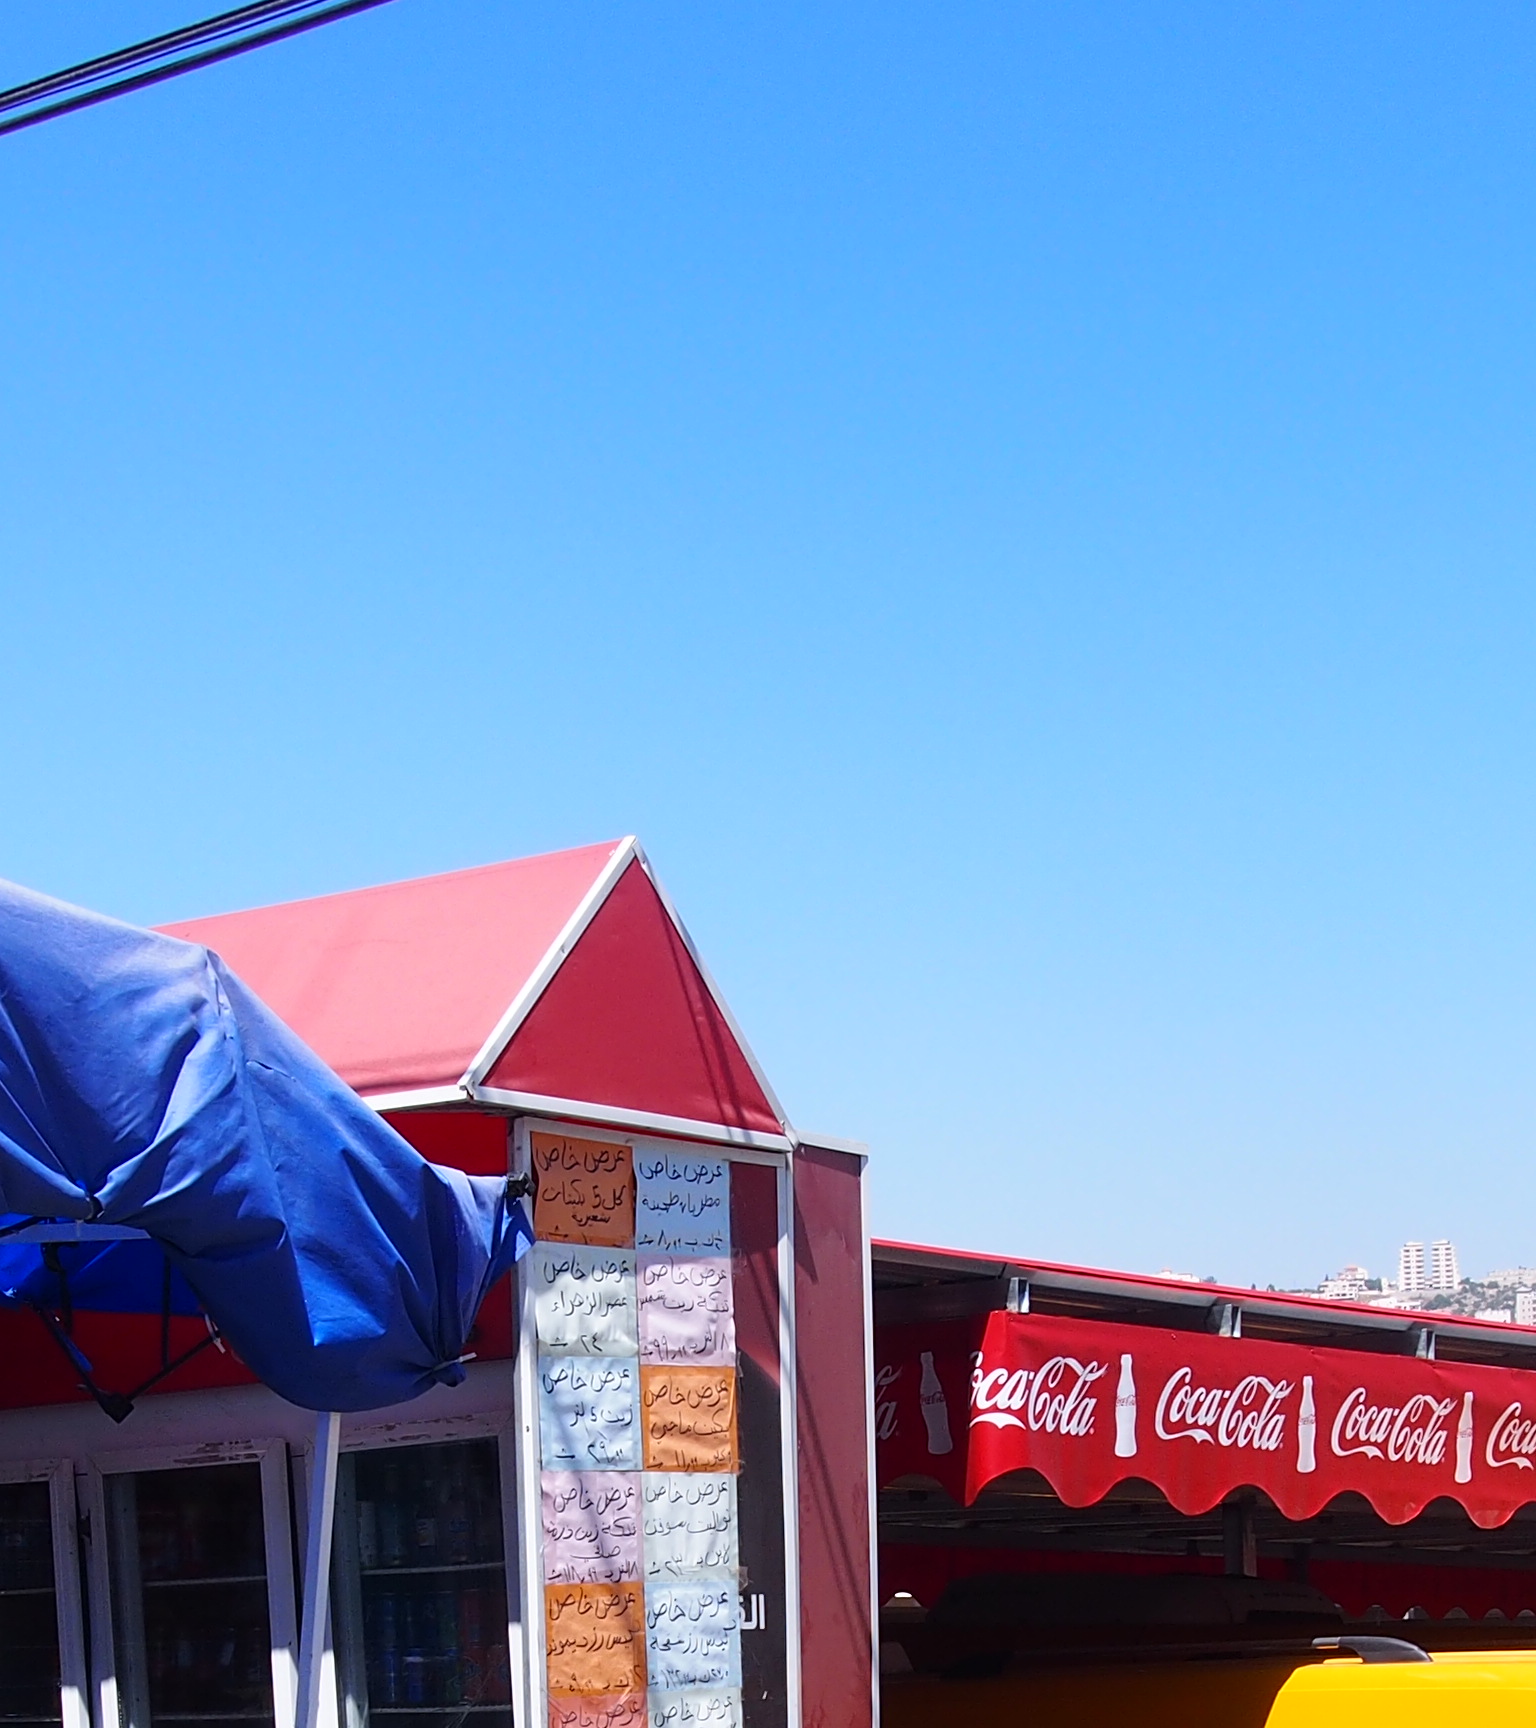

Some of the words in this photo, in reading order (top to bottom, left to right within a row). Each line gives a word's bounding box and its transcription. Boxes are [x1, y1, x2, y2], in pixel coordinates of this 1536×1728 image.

[536, 1141, 581, 1171] خاص
[639, 1154, 682, 1180] خاص
[544, 1254, 586, 1283] خاص
[644, 1256, 688, 1285] خاص
[543, 1363, 587, 1394] خاص
[644, 1375, 685, 1407] خاص
[1155, 1366, 1295, 1450] Coca-Cola
[1331, 1388, 1458, 1465] Coca-Cola
[552, 1478, 594, 1513] خاص
[645, 1478, 683, 1504] خاص
[549, 1587, 592, 1620] خاص
[647, 1590, 686, 1629] خاص
[654, 1698, 694, 1727] خاص
